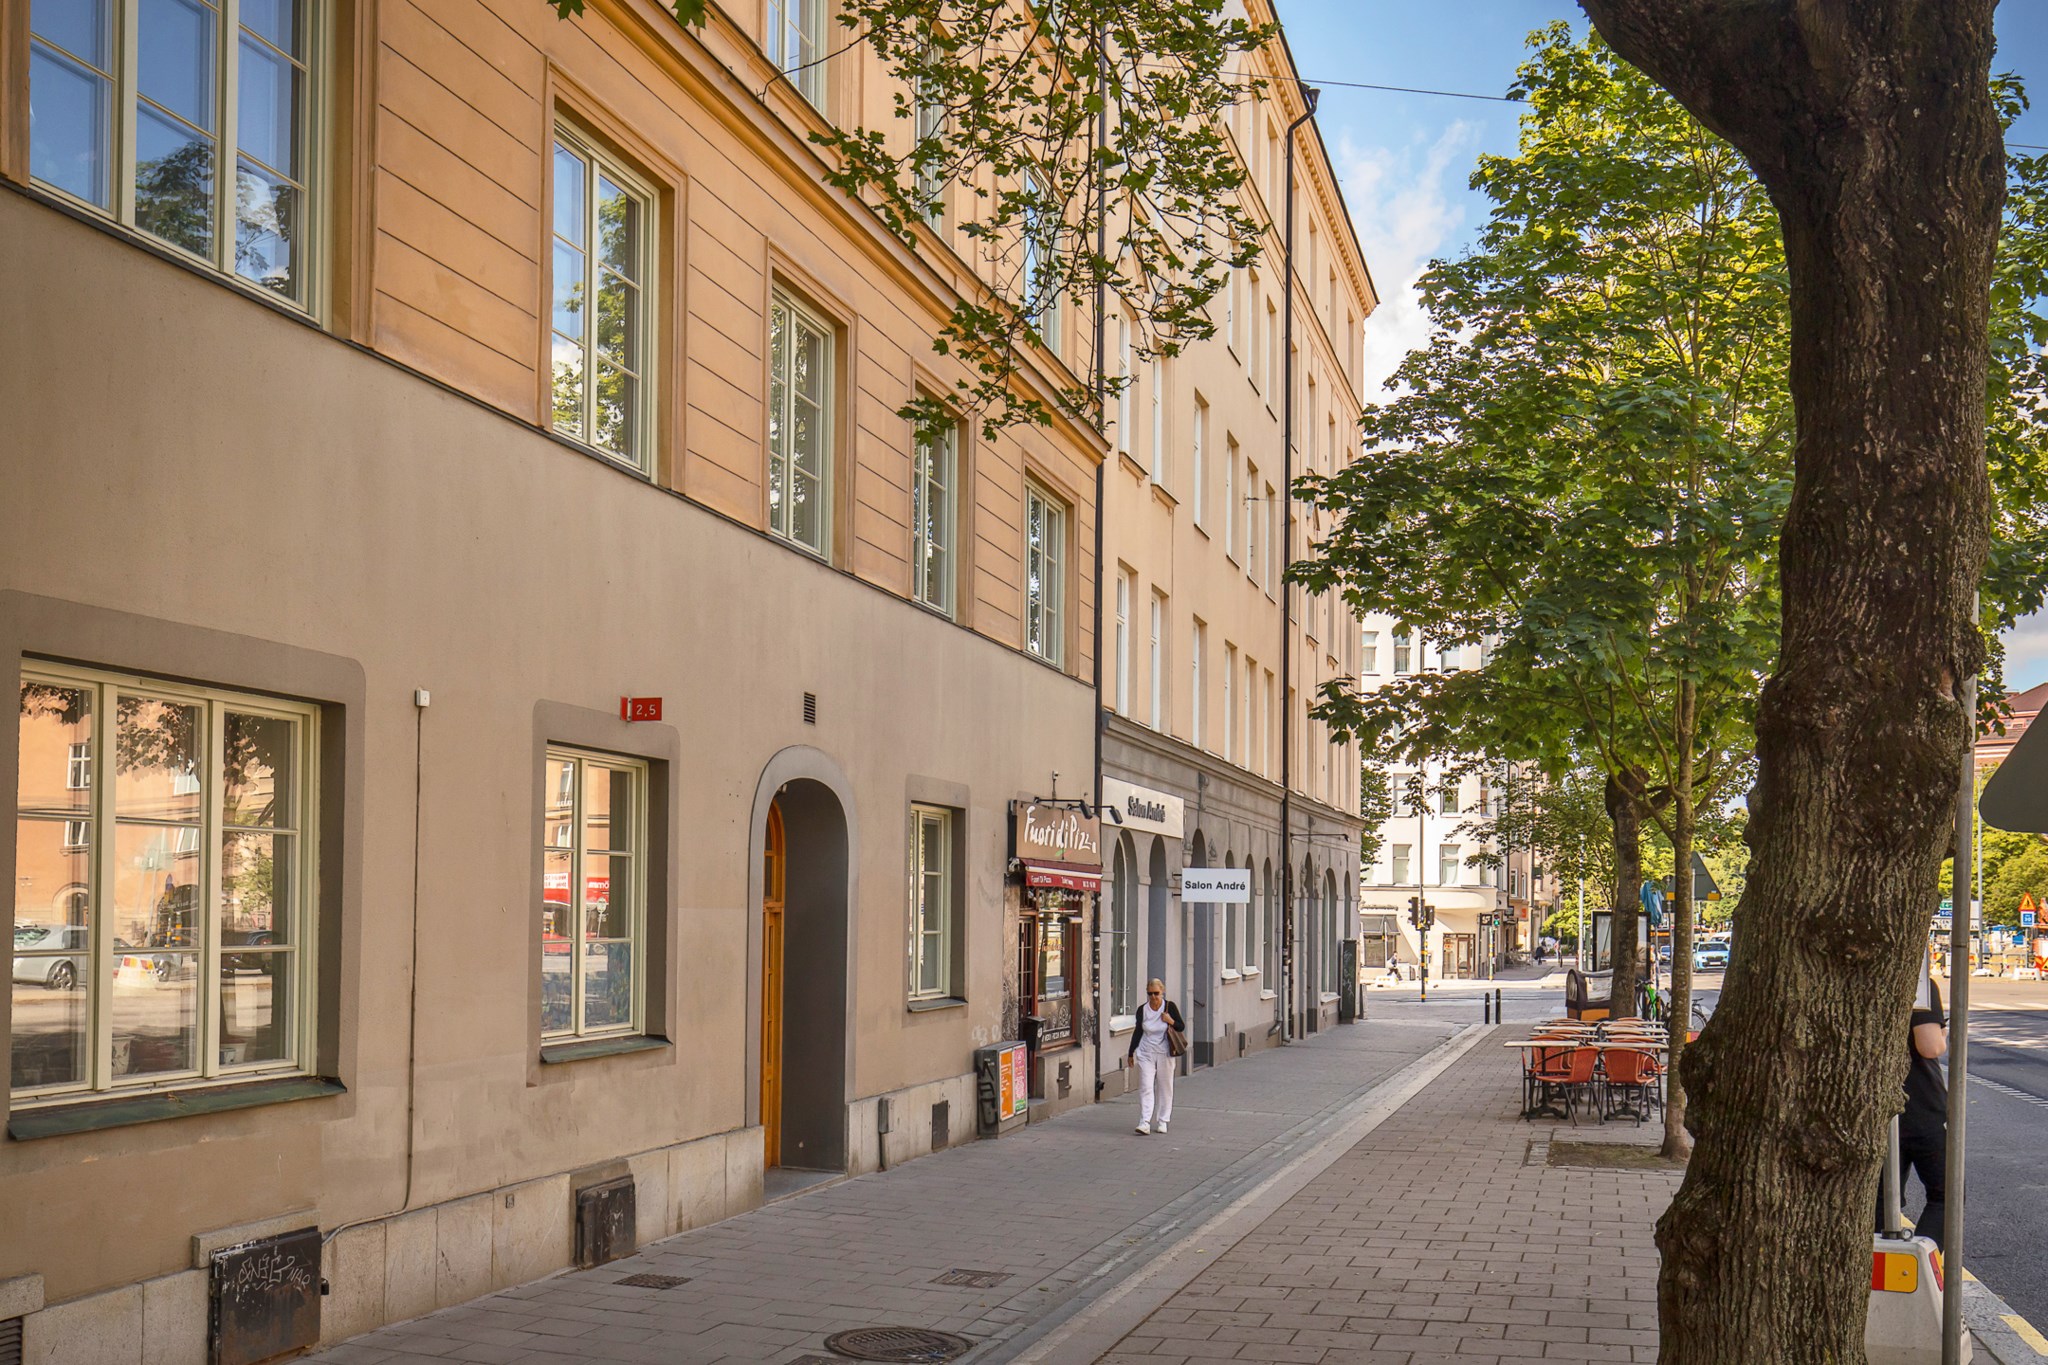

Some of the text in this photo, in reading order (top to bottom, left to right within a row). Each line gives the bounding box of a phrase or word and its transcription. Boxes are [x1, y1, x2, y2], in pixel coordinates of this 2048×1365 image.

[1127, 795, 1166, 823] Salon André
[1023, 805, 1056, 848] Fuori
[1184, 880, 1246, 891] Salon André
